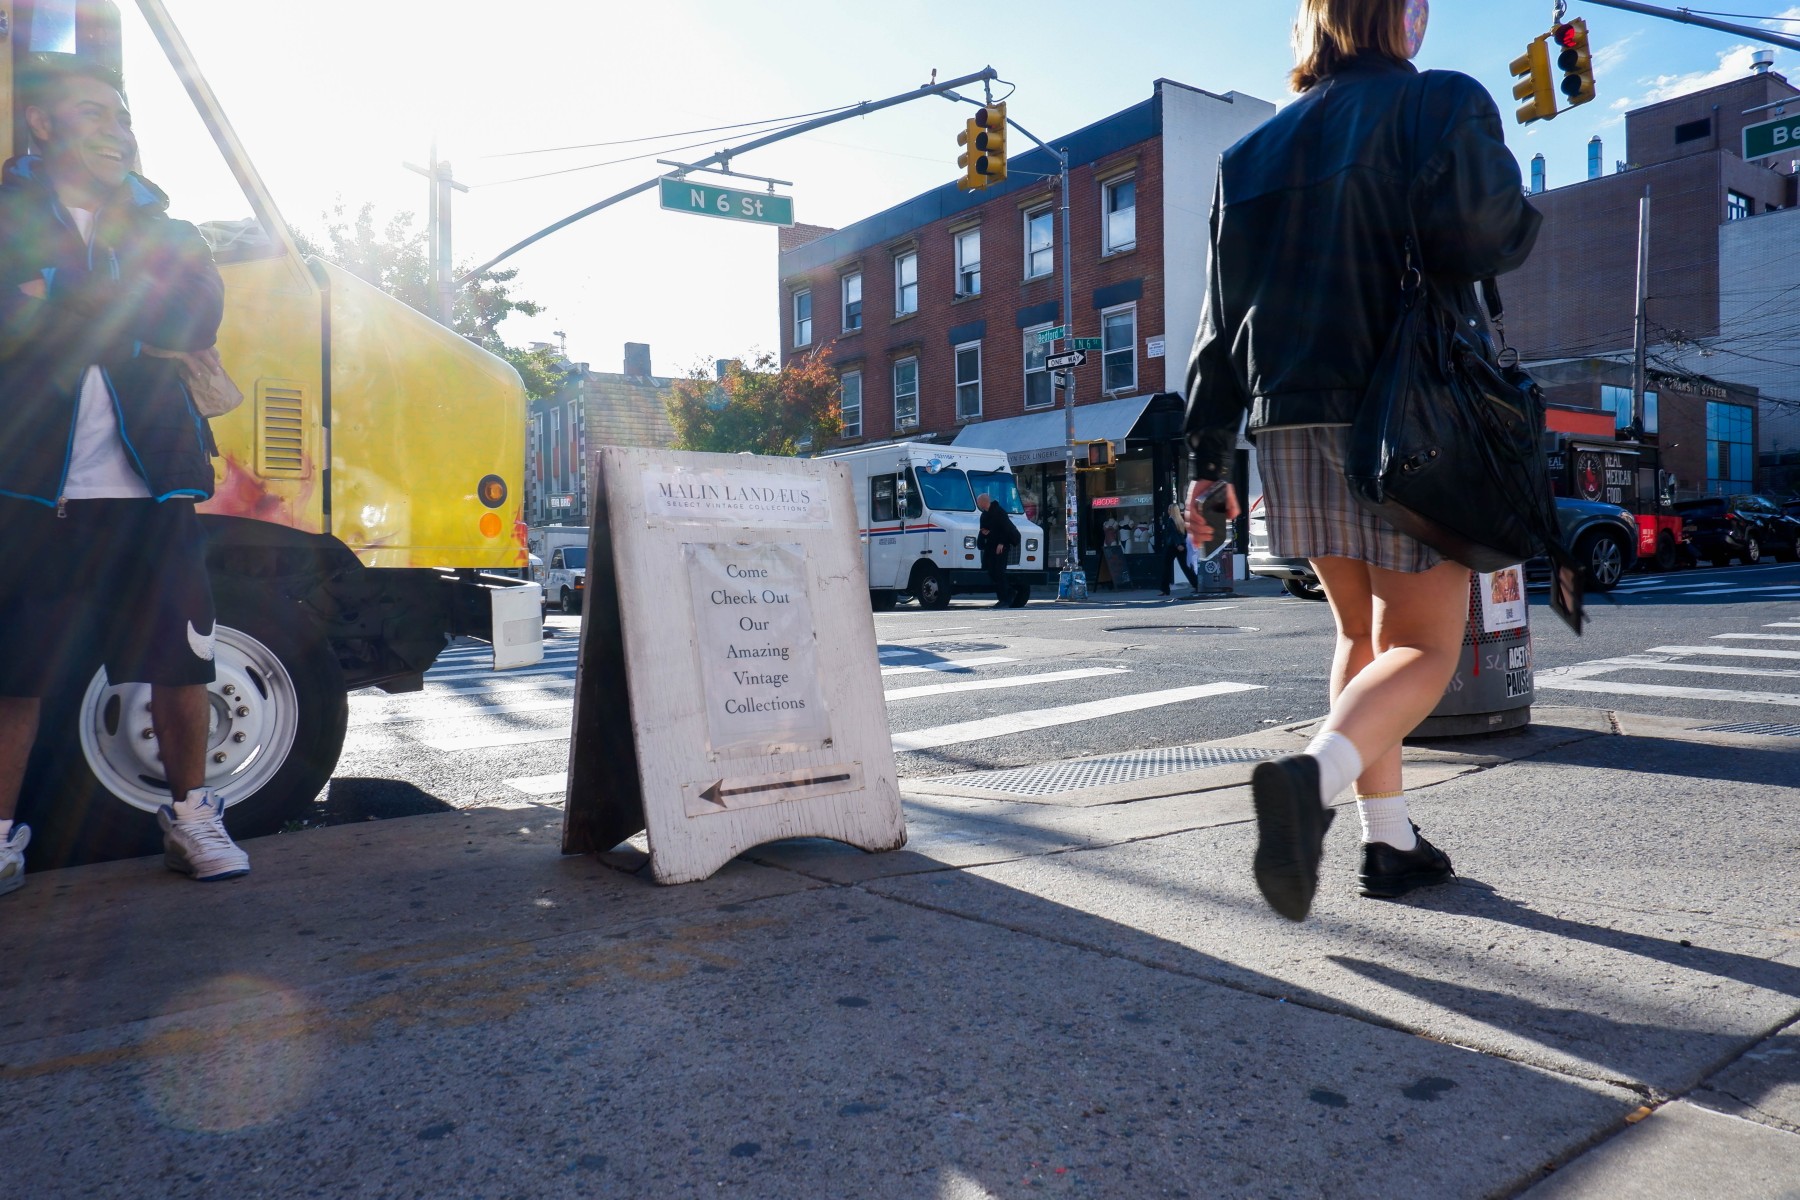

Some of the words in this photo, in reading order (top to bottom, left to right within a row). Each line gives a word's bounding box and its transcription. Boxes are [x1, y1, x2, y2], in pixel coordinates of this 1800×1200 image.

[691, 189, 705, 209] N
[716, 194, 730, 212] 6
[741, 197, 764, 217] St
[1038, 328, 1059, 343] Bedford
[1078, 339, 1084, 349] N
[1086, 339, 1091, 349] 6
[1050, 358, 1063, 367] ONE
[1067, 354, 1081, 363] WAY
[1020, 453, 1031, 461] FOX
[1033, 450, 1059, 460] LINGERIE
[1604, 453, 1622, 468] REAL
[1605, 470, 1632, 486] MEXICAN
[658, 482, 720, 500] MALIN
[1606, 487, 1622, 504] FOOD
[666, 500, 701, 508] SELECT
[706, 502, 745, 510] VINTAGE
[749, 504, 808, 512] COLLECTIONS
[726, 564, 768, 579] Come
[711, 589, 758, 605] Check
[762, 589, 790, 604] Out
[739, 616, 769, 631] Our
[726, 643, 790, 661] Amazing
[733, 671, 789, 688] Vintage
[1506, 670, 1529, 697] PAUSE
[724, 697, 806, 714] Collections
